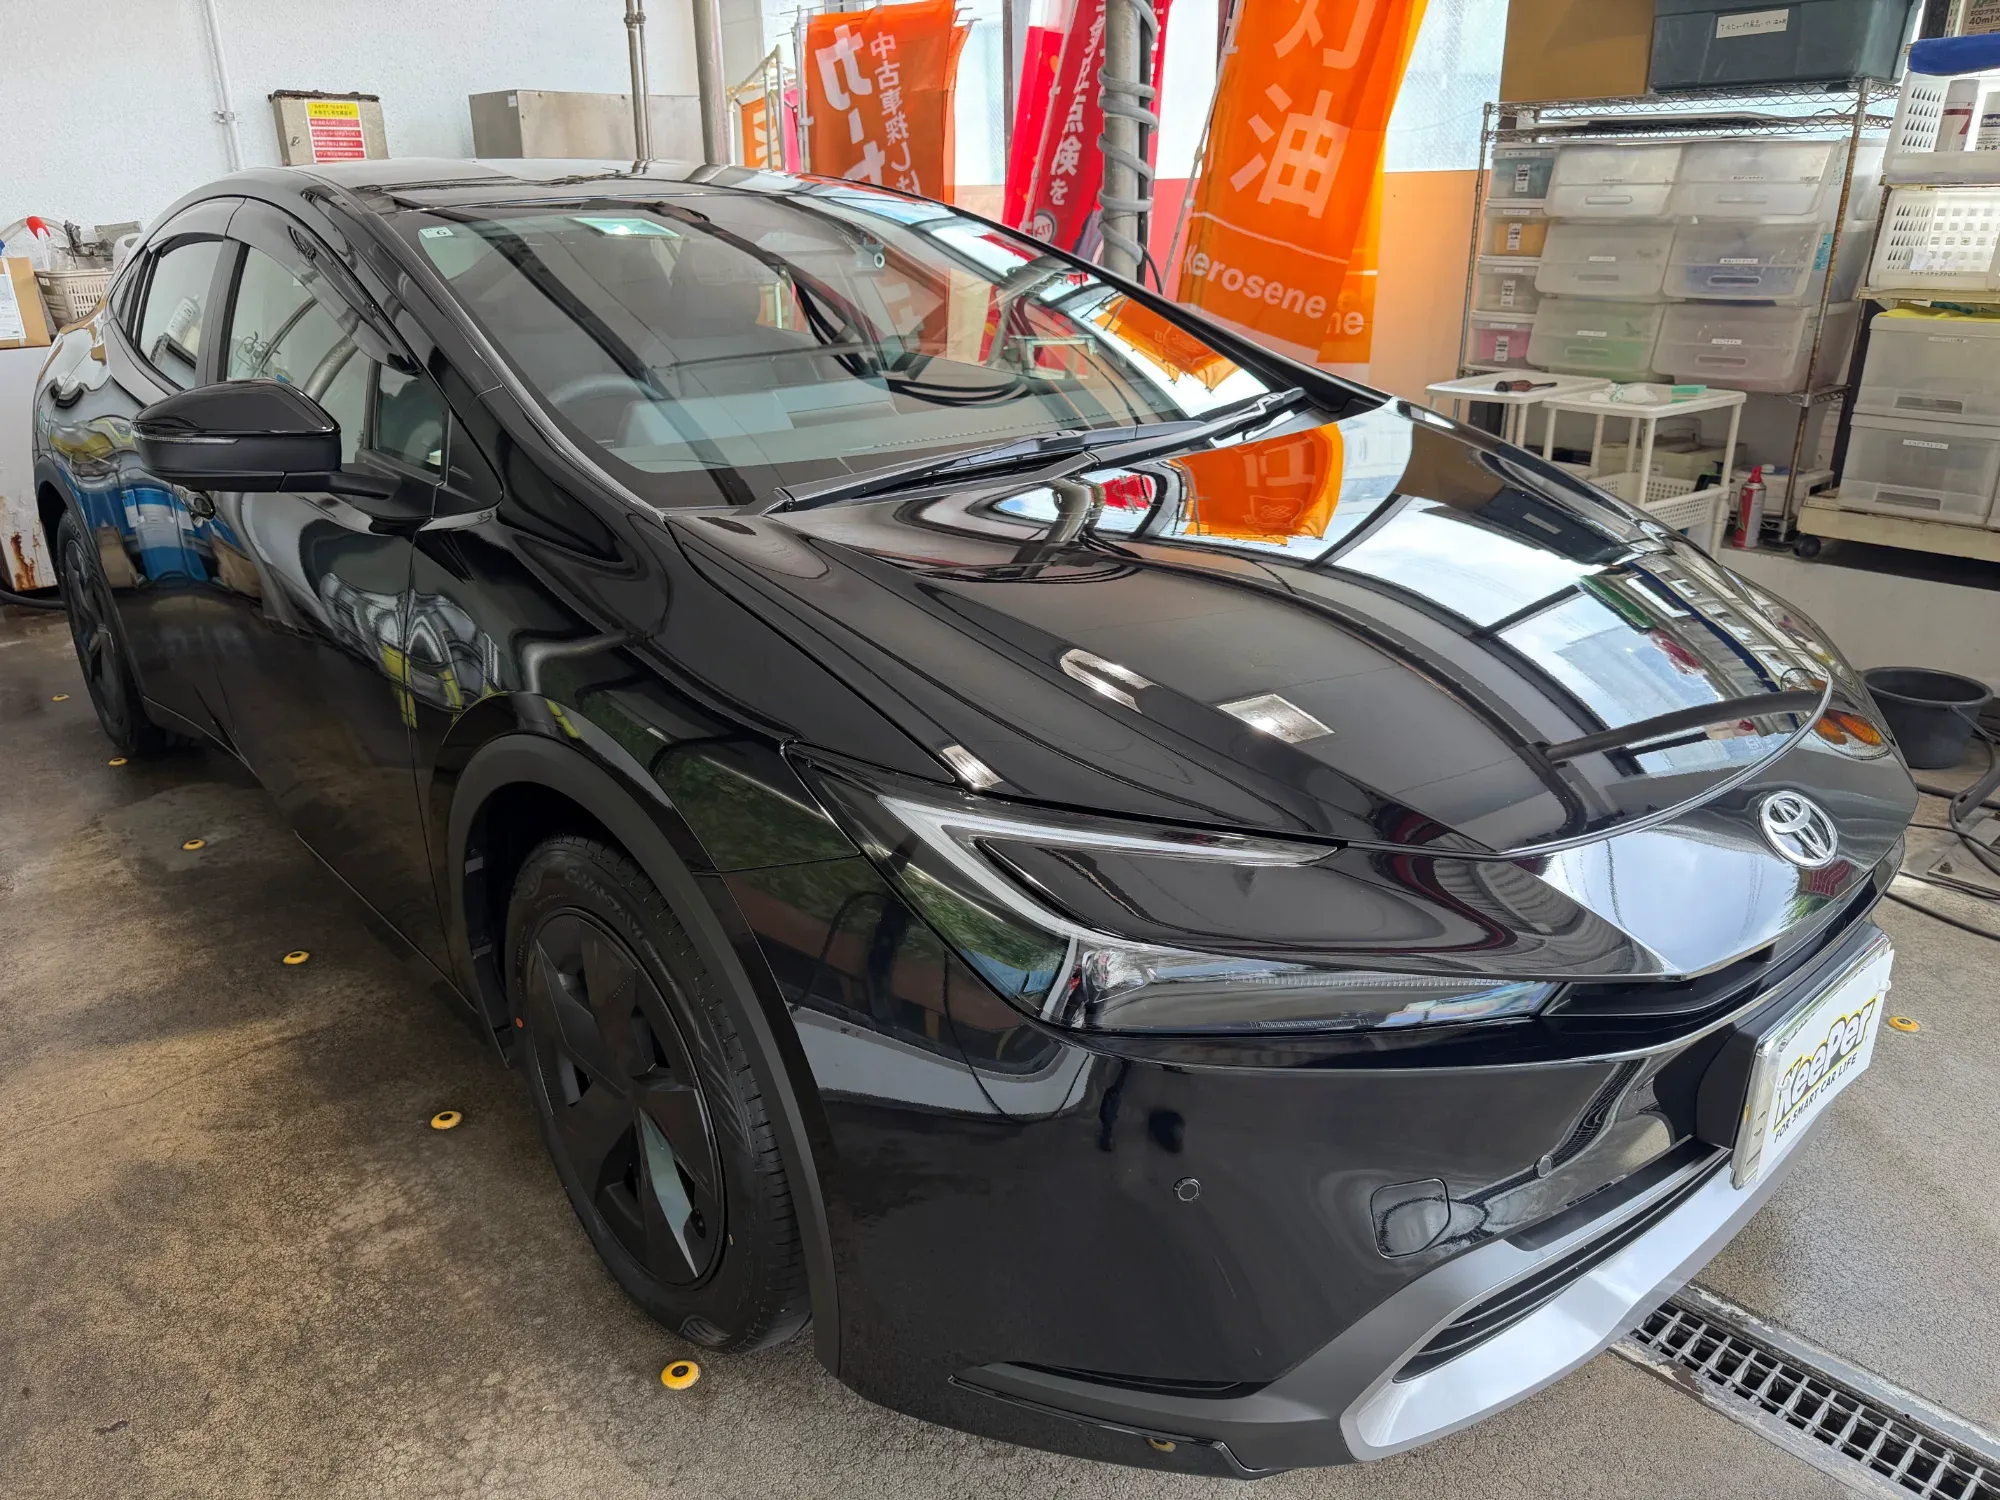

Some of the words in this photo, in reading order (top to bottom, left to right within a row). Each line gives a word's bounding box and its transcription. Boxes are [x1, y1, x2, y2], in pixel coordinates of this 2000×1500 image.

[1183, 243, 1328, 319] Kerosene
[1774, 996, 1877, 1132] KeePer
[1774, 1118, 1791, 1144] FOR
[1791, 1086, 1820, 1124] SMART
[1821, 1071, 1837, 1095] CAR
[1838, 1052, 1858, 1079] LIFE
